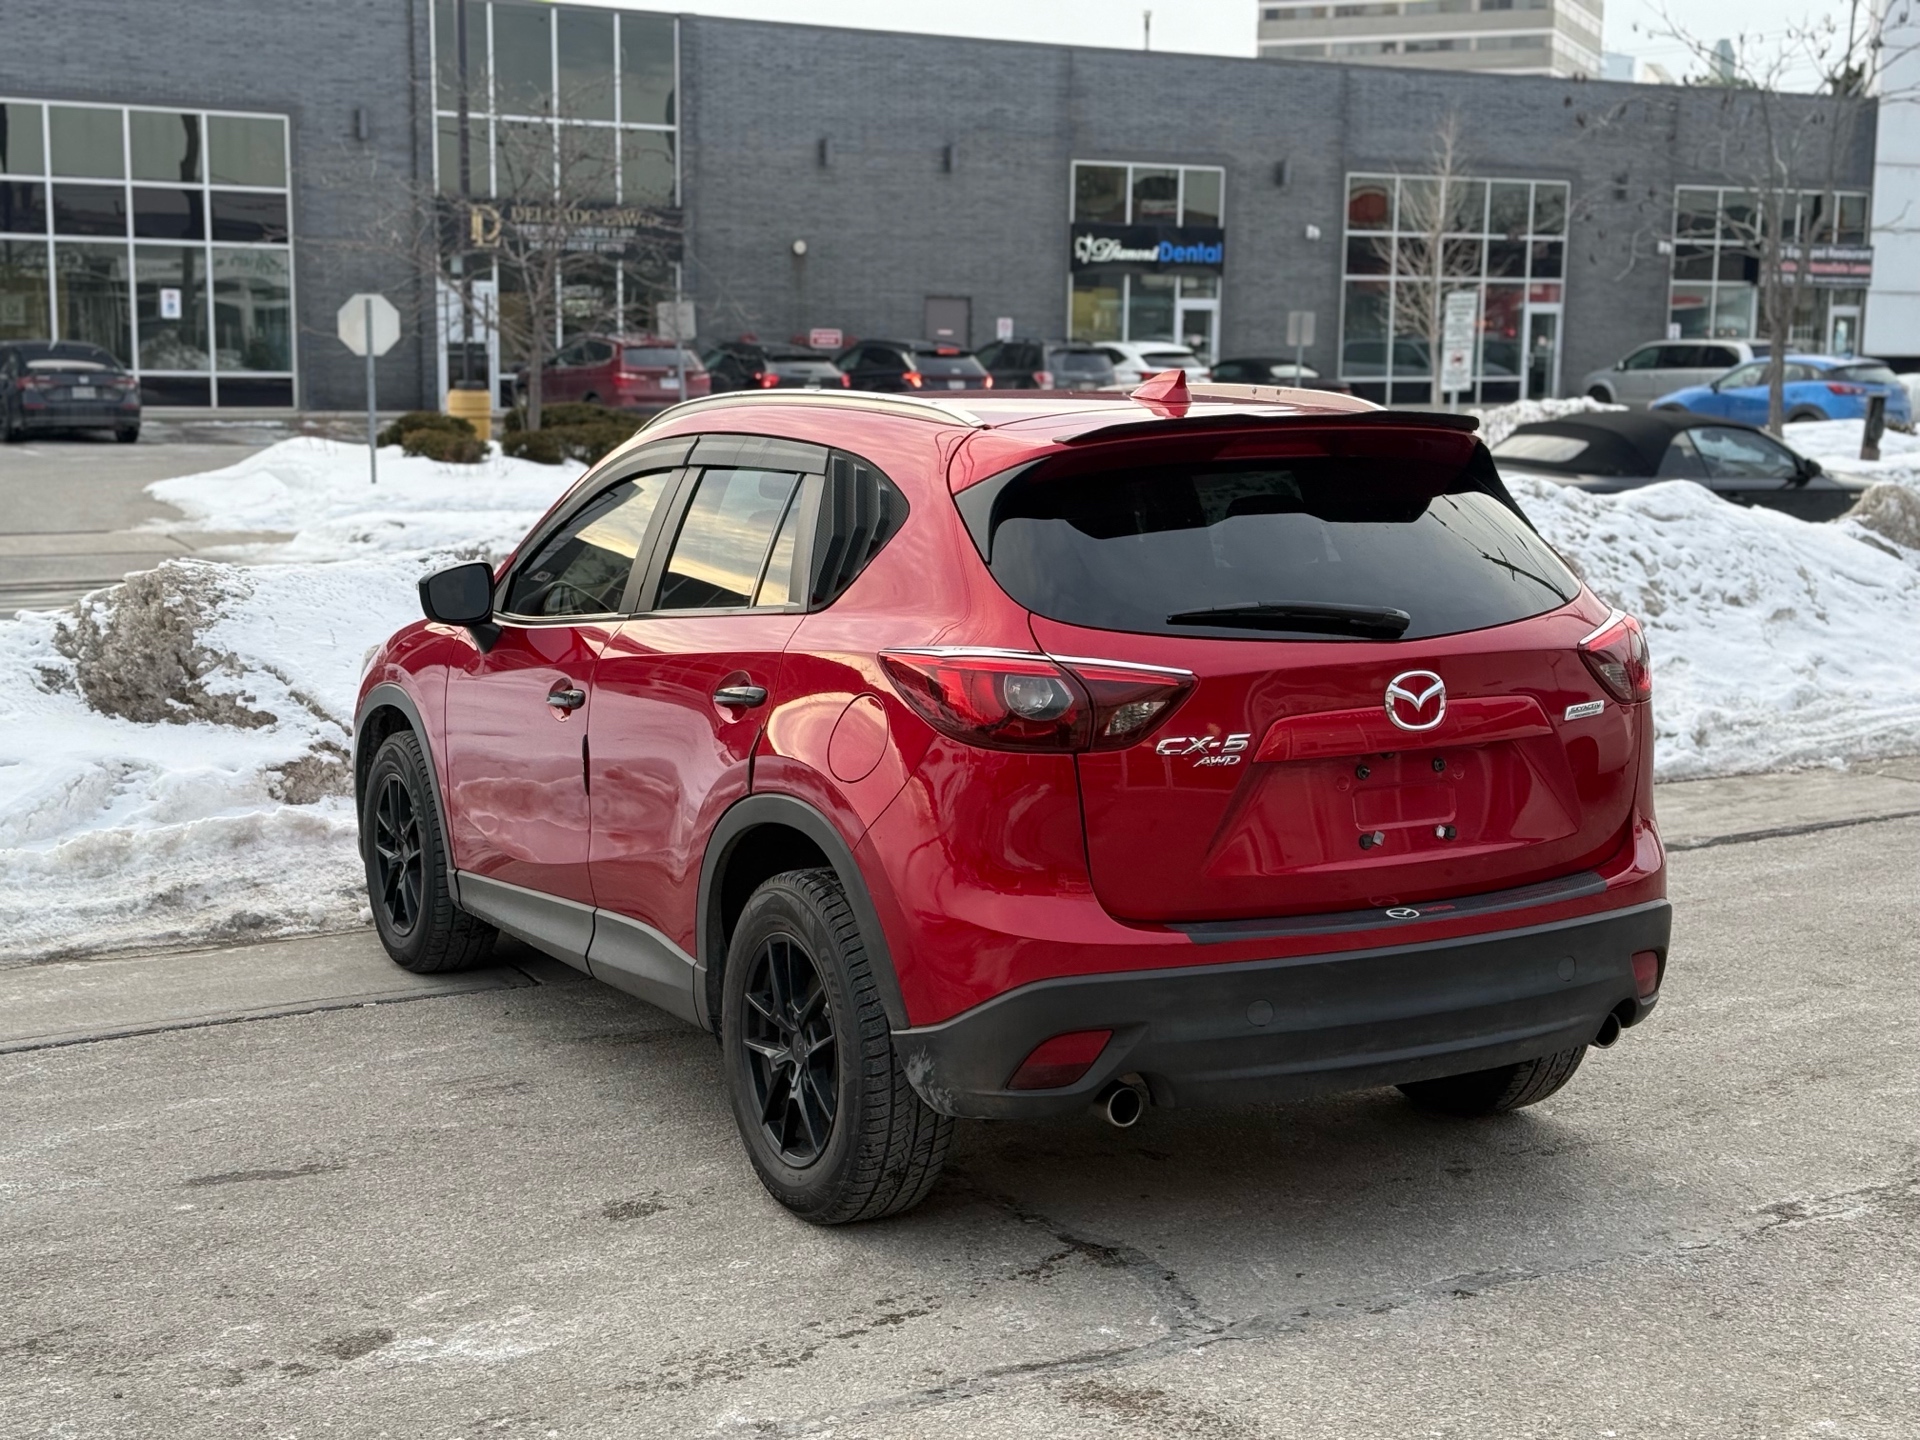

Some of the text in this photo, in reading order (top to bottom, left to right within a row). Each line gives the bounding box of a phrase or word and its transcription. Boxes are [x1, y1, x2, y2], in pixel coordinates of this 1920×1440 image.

[1090, 237, 1223, 263] Diamond Dental
[1156, 733, 1251, 755] CX-5
[1193, 755, 1241, 768] AWD
